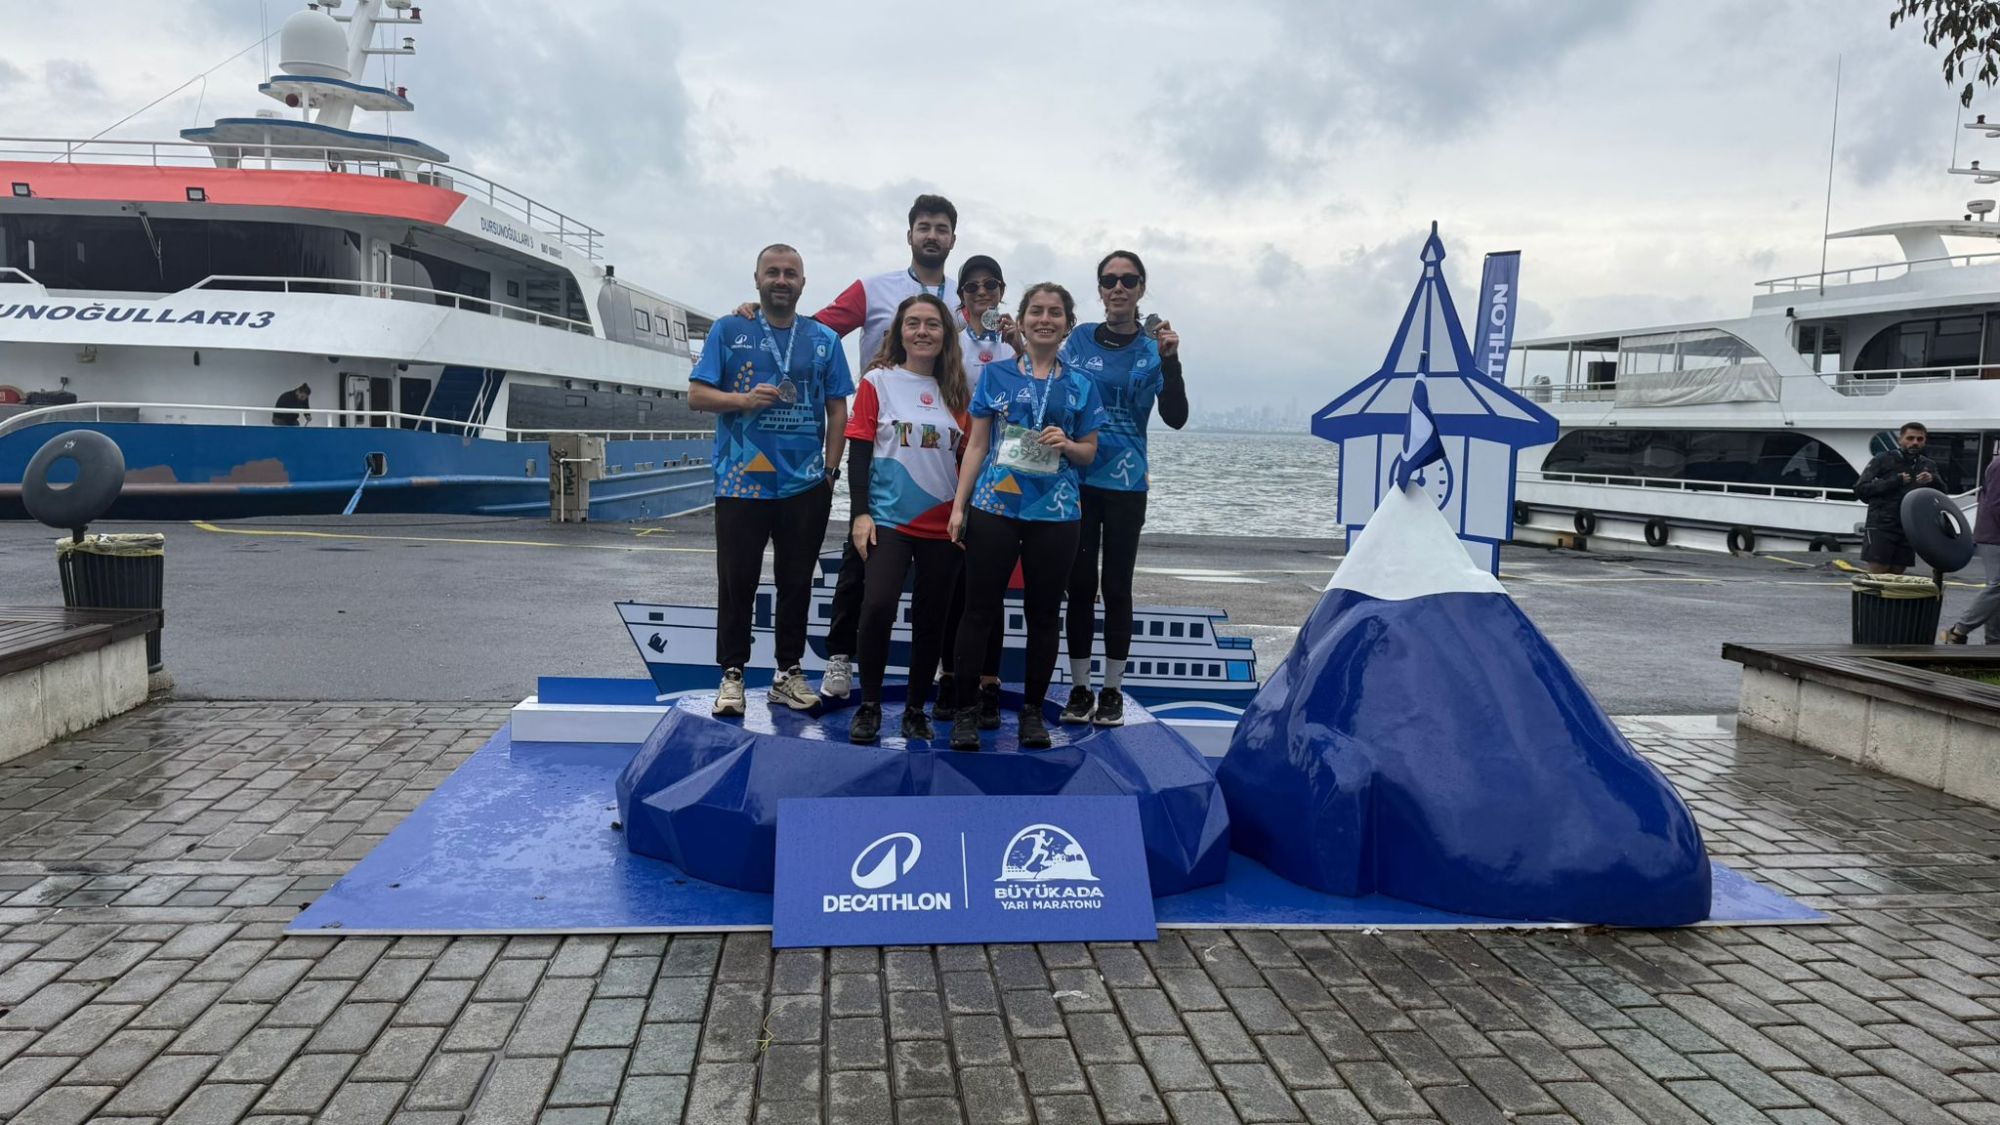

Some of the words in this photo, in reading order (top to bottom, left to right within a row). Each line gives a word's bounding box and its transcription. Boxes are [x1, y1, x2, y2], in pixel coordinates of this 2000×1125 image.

[1488, 283, 1509, 384] THLON
[994, 884, 1104, 899] BÜYÜKADA
[823, 892, 951, 912] DECATHLON
[1001, 900, 1029, 910] YARI
[1032, 900, 1102, 910] MARATONU
